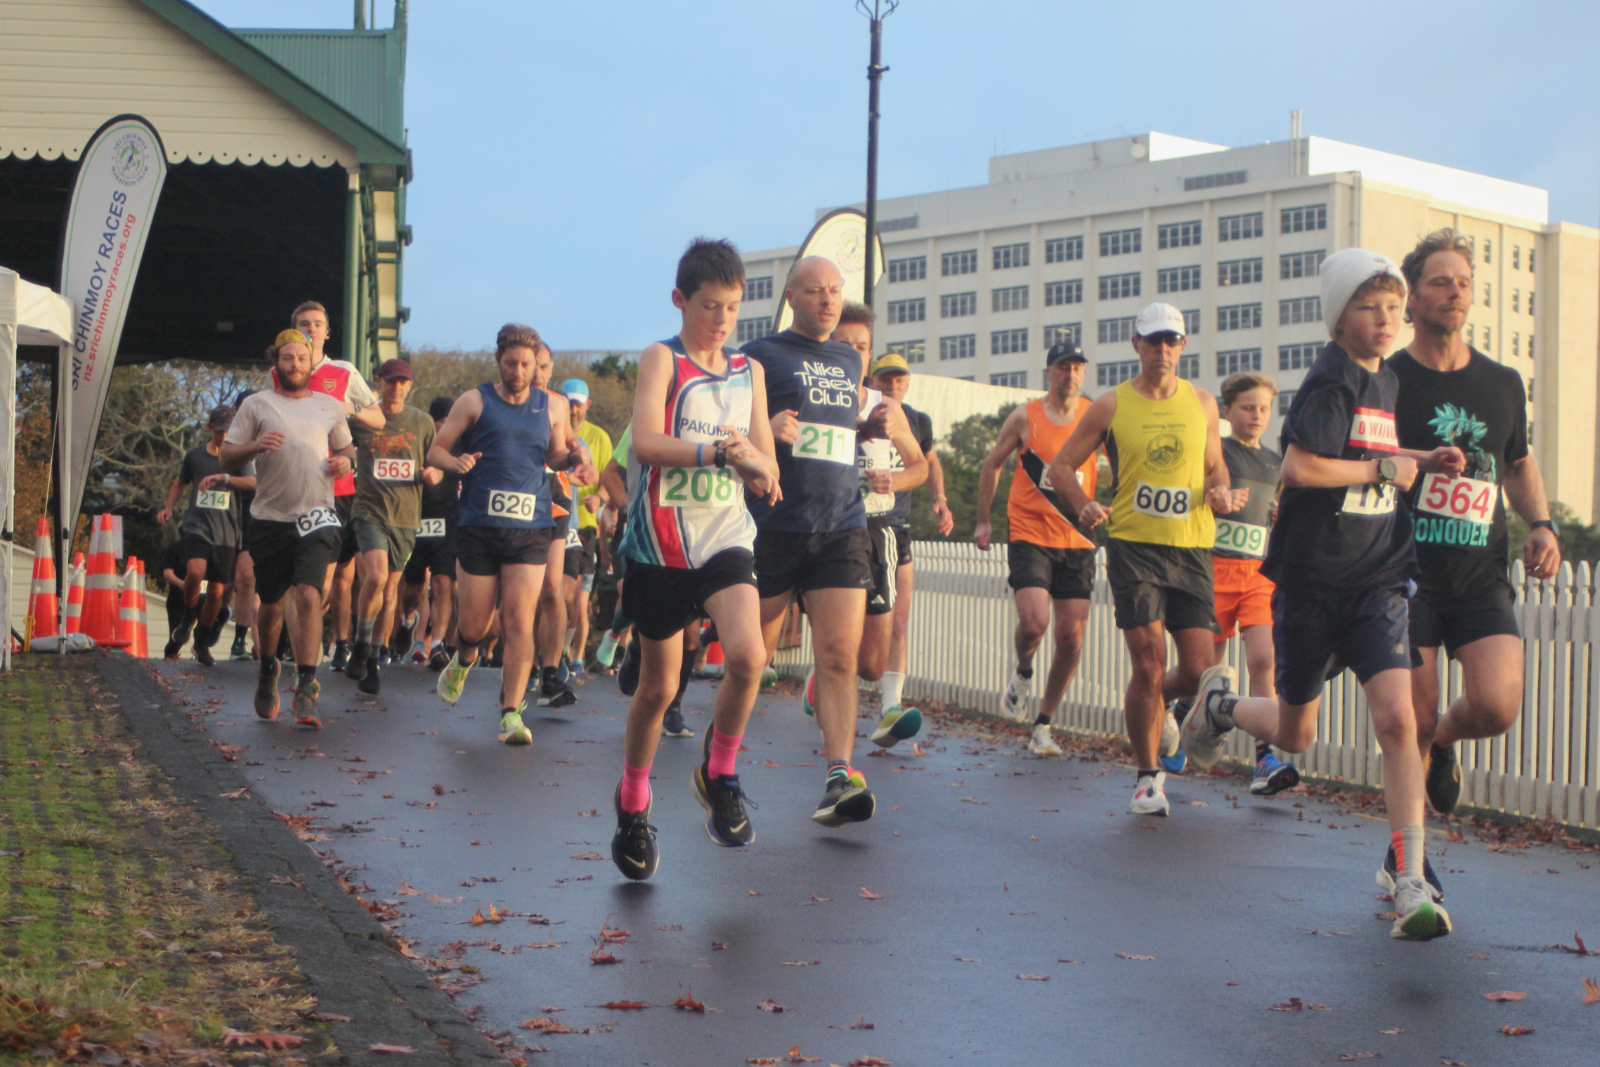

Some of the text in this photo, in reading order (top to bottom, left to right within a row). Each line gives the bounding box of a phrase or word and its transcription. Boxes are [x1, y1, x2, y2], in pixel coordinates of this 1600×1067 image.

[71, 190, 127, 392] SRI CHINMOY RACES
[83, 213, 137, 382] nz.srichinmoyraces.org
[794, 371, 858, 394] Track
[803, 361, 846, 378] Nike
[809, 387, 853, 408] Club
[800, 425, 848, 457] 211
[377, 461, 411, 478] 563
[200, 491, 226, 507] 214
[665, 467, 732, 502] 208
[1425, 475, 1490, 519] 564
[491, 492, 533, 517] 626
[1136, 485, 1187, 514] 608
[297, 508, 338, 532] 623
[1411, 517, 1489, 547] ONQUER
[1215, 521, 1263, 551] 209
